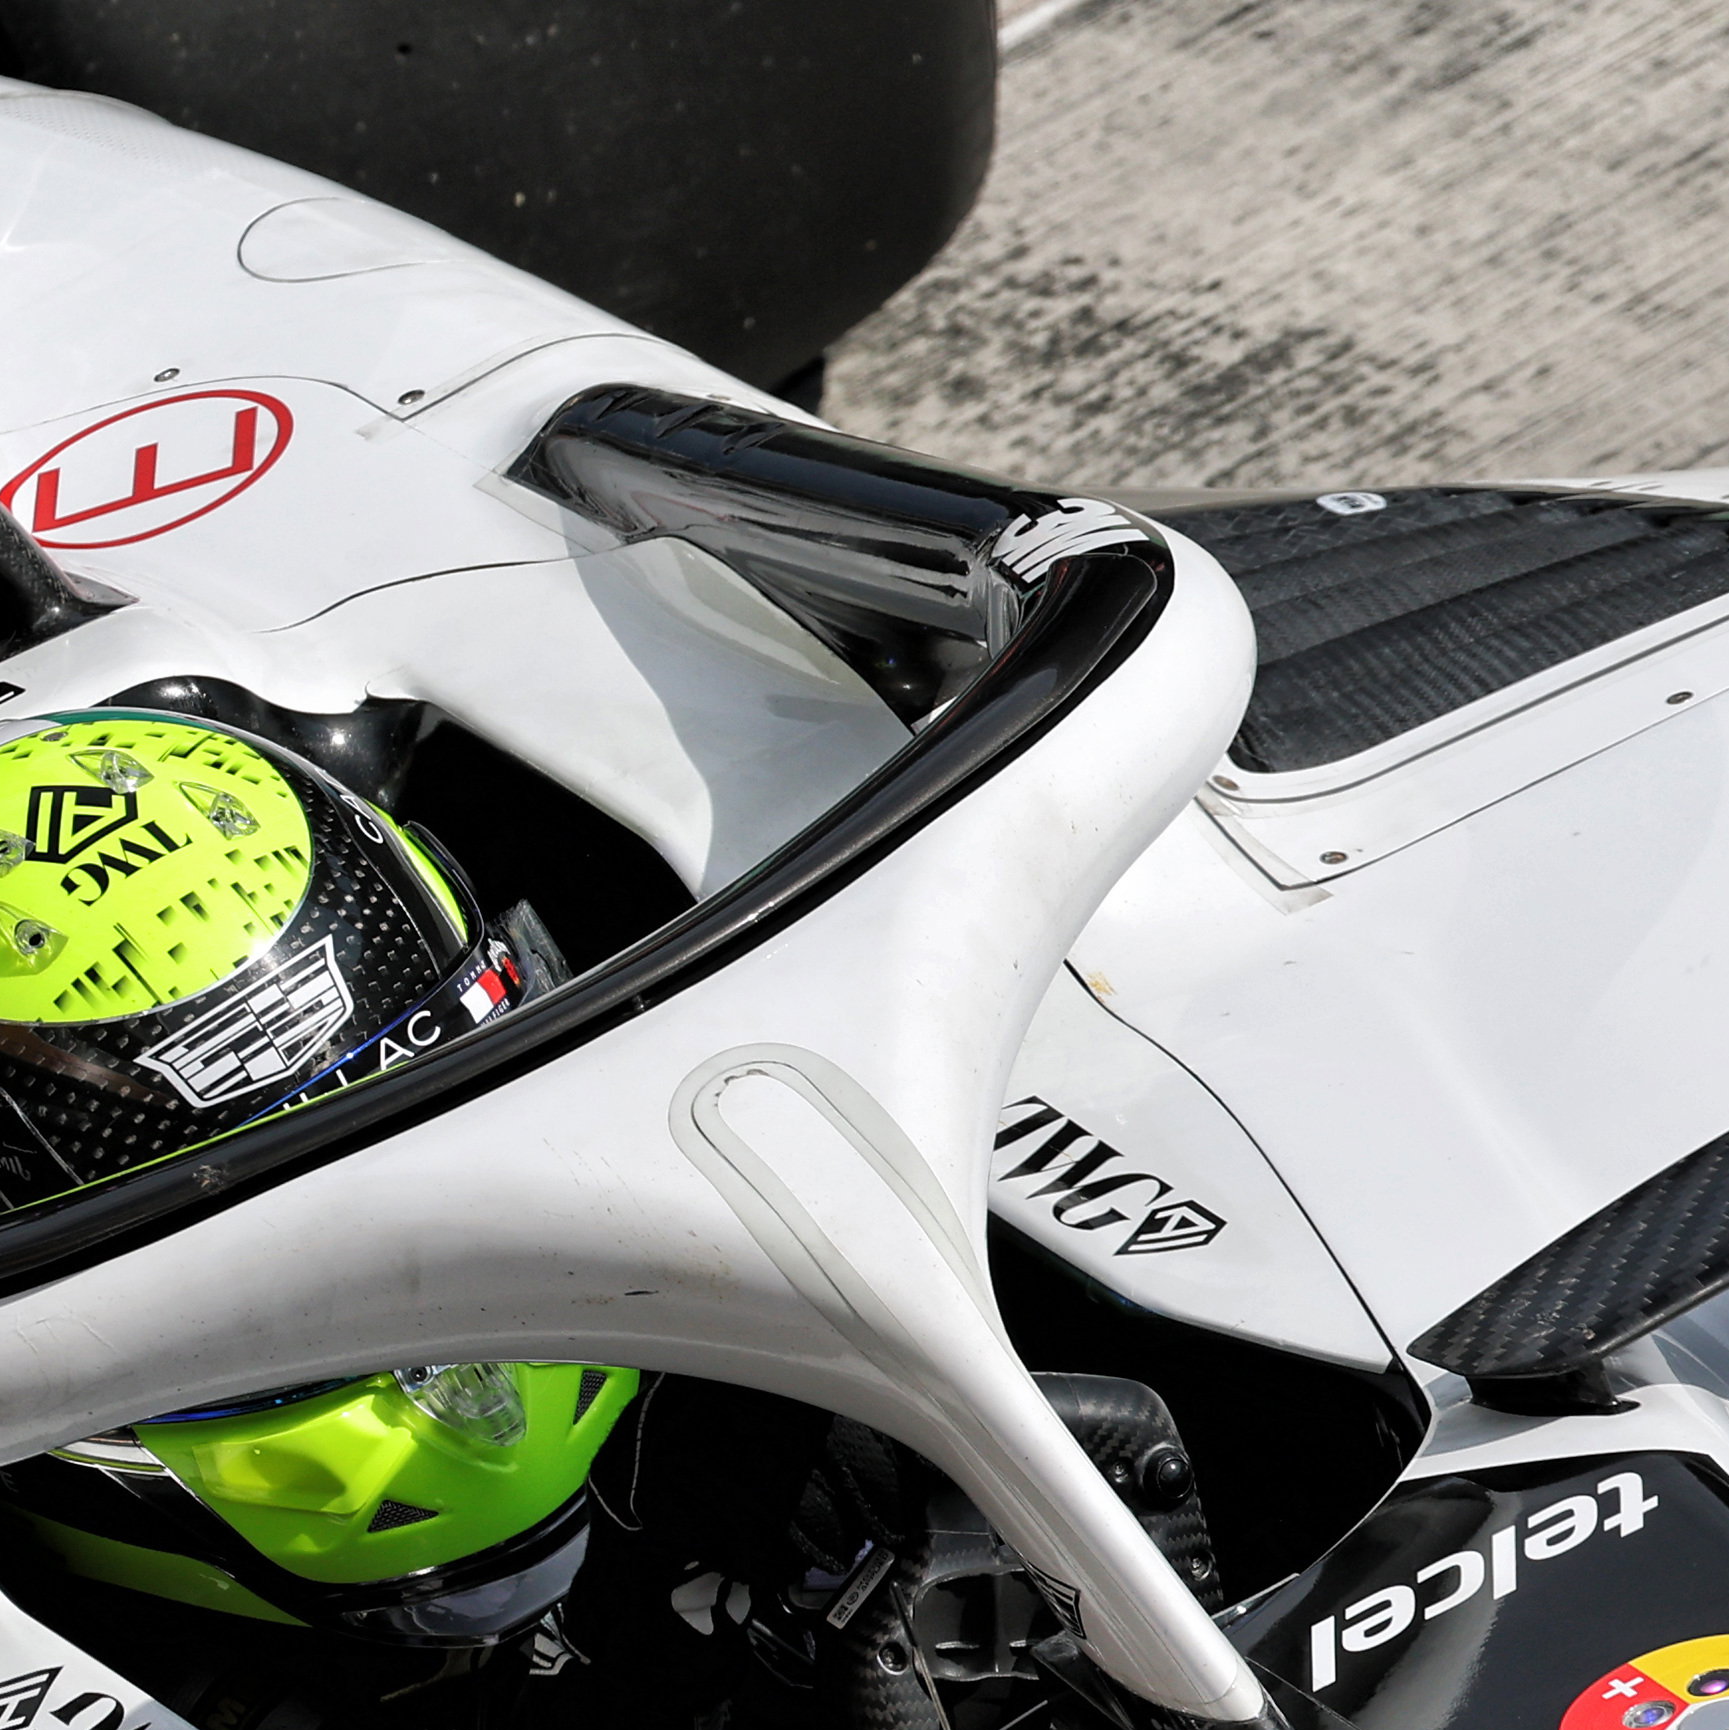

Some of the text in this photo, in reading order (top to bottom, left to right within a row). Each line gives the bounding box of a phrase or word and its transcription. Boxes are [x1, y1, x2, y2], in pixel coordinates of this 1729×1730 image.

[60, 820, 193, 906] TWG
[993, 1095, 1174, 1231] TWG
[1310, 1471, 1659, 1692] telcel
